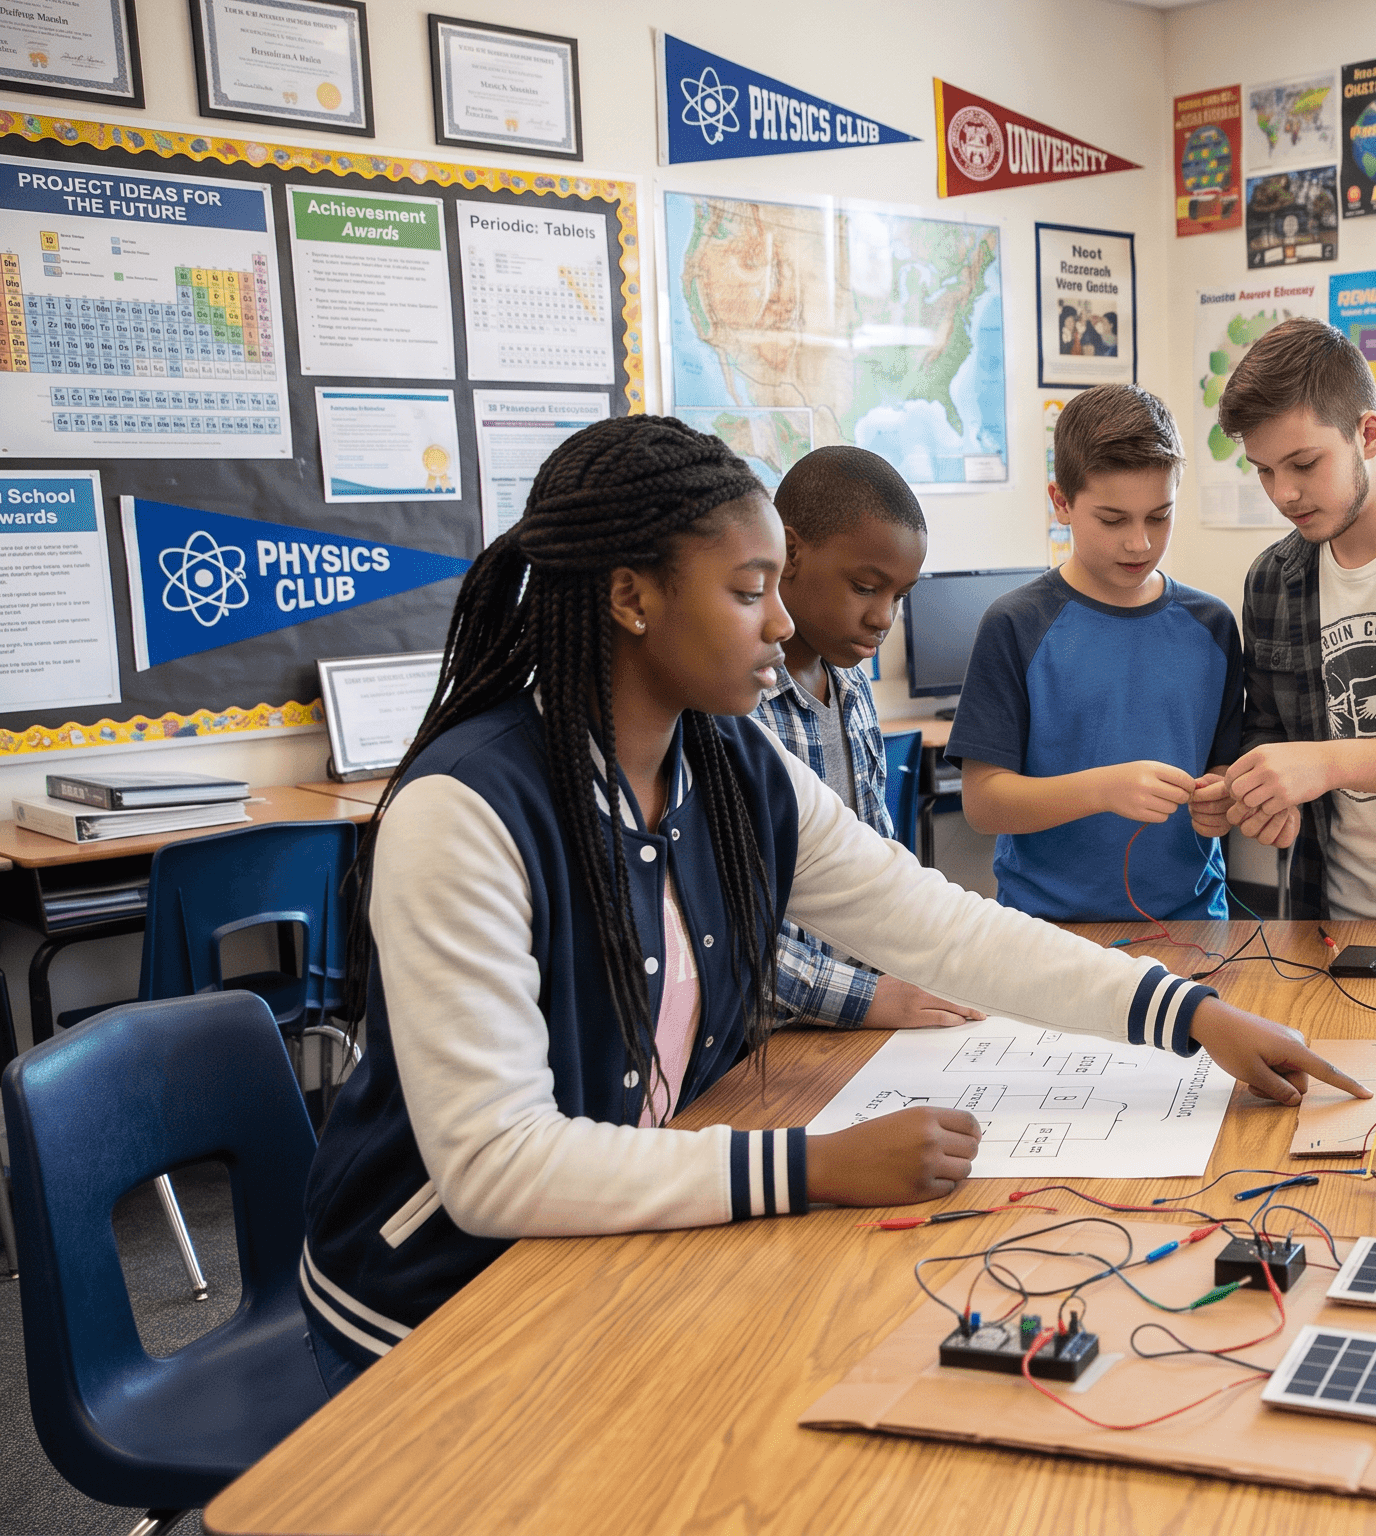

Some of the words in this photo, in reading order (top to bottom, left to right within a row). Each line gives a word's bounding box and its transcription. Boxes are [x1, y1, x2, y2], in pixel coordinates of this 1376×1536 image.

[748, 84, 831, 143] PHYSICS
[836, 114, 880, 144] CLUB
[1005, 121, 1108, 174] UNIVERSITY
[18, 172, 114, 196] PROJECT
[120, 183, 178, 202] IDEAS
[183, 189, 222, 206] FOR
[64, 196, 104, 214] THE
[110, 200, 187, 221] FUTURE
[307, 200, 426, 224] Achievesment
[342, 222, 399, 240] Awards
[470, 215, 539, 234] Periodic:
[7, 488, 76, 504] School
[0, 509, 58, 525] wards
[257, 540, 391, 576] PHYSICS
[275, 576, 356, 612] CLUB
